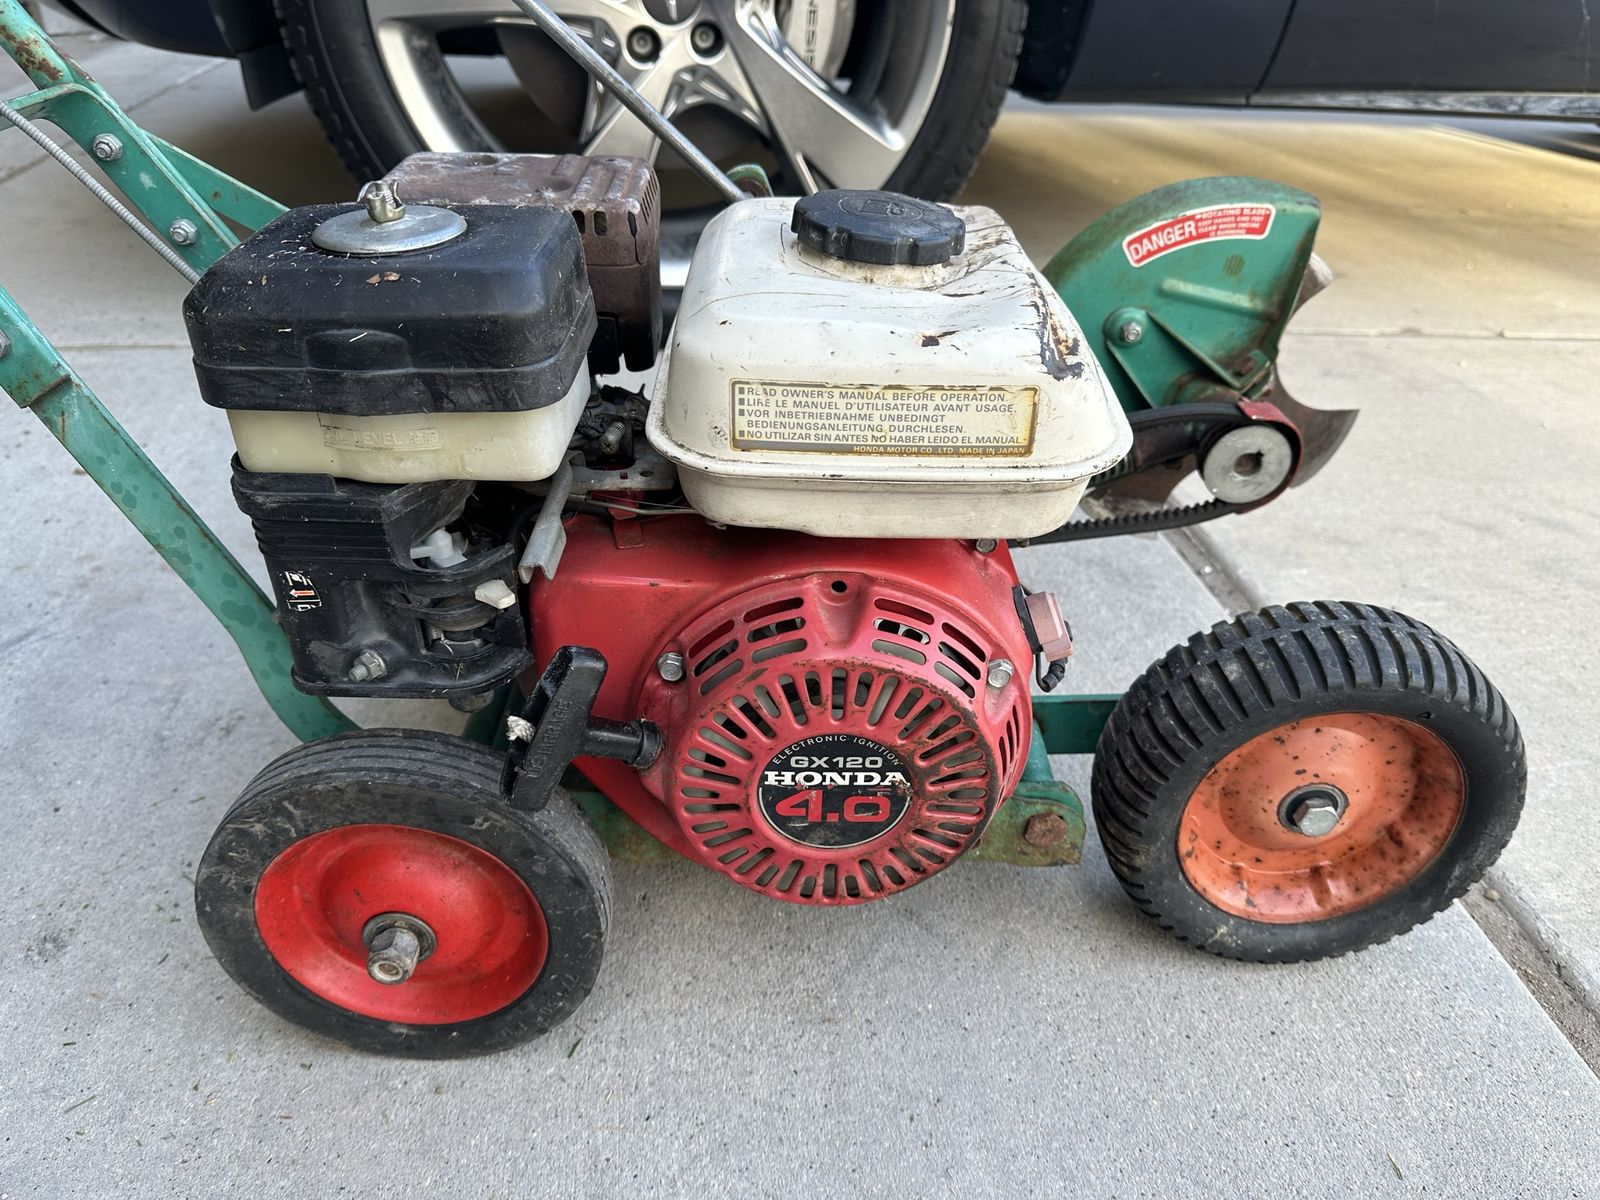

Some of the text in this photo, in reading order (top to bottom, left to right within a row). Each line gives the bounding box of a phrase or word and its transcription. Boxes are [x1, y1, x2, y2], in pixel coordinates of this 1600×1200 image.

[1129, 220, 1196, 261] DANGER
[747, 387, 1009, 402] READ OWNER'S MANUAL BEFORE OPERATION.
[775, 399, 788, 408] LE
[792, 400, 841, 410] MANUEL
[845, 402, 929, 412] D'UTILISATEUR
[933, 403, 971, 412] AVANT
[975, 404, 1017, 414] USAGE.
[747, 408, 946, 423] VOR INBETRIEBNAHME UNBEDINGT
[747, 419, 967, 434] BEDIENUNGSANLEITUNG DURCHLESEN.
[747, 430, 1024, 445] NO UTILIZAR SIN ANTES NO HABER LEIDO EL MANUAL.
[853, 445, 885, 453] HONDA
[886, 446, 919, 454] MOTOR
[959, 447, 984, 455] MADE
[997, 447, 1025, 455] JAPAN
[773, 734, 900, 766] ELECTRONIC IGNITION
[764, 771, 911, 786] HONDA
[775, 789, 891, 823] 4.0
